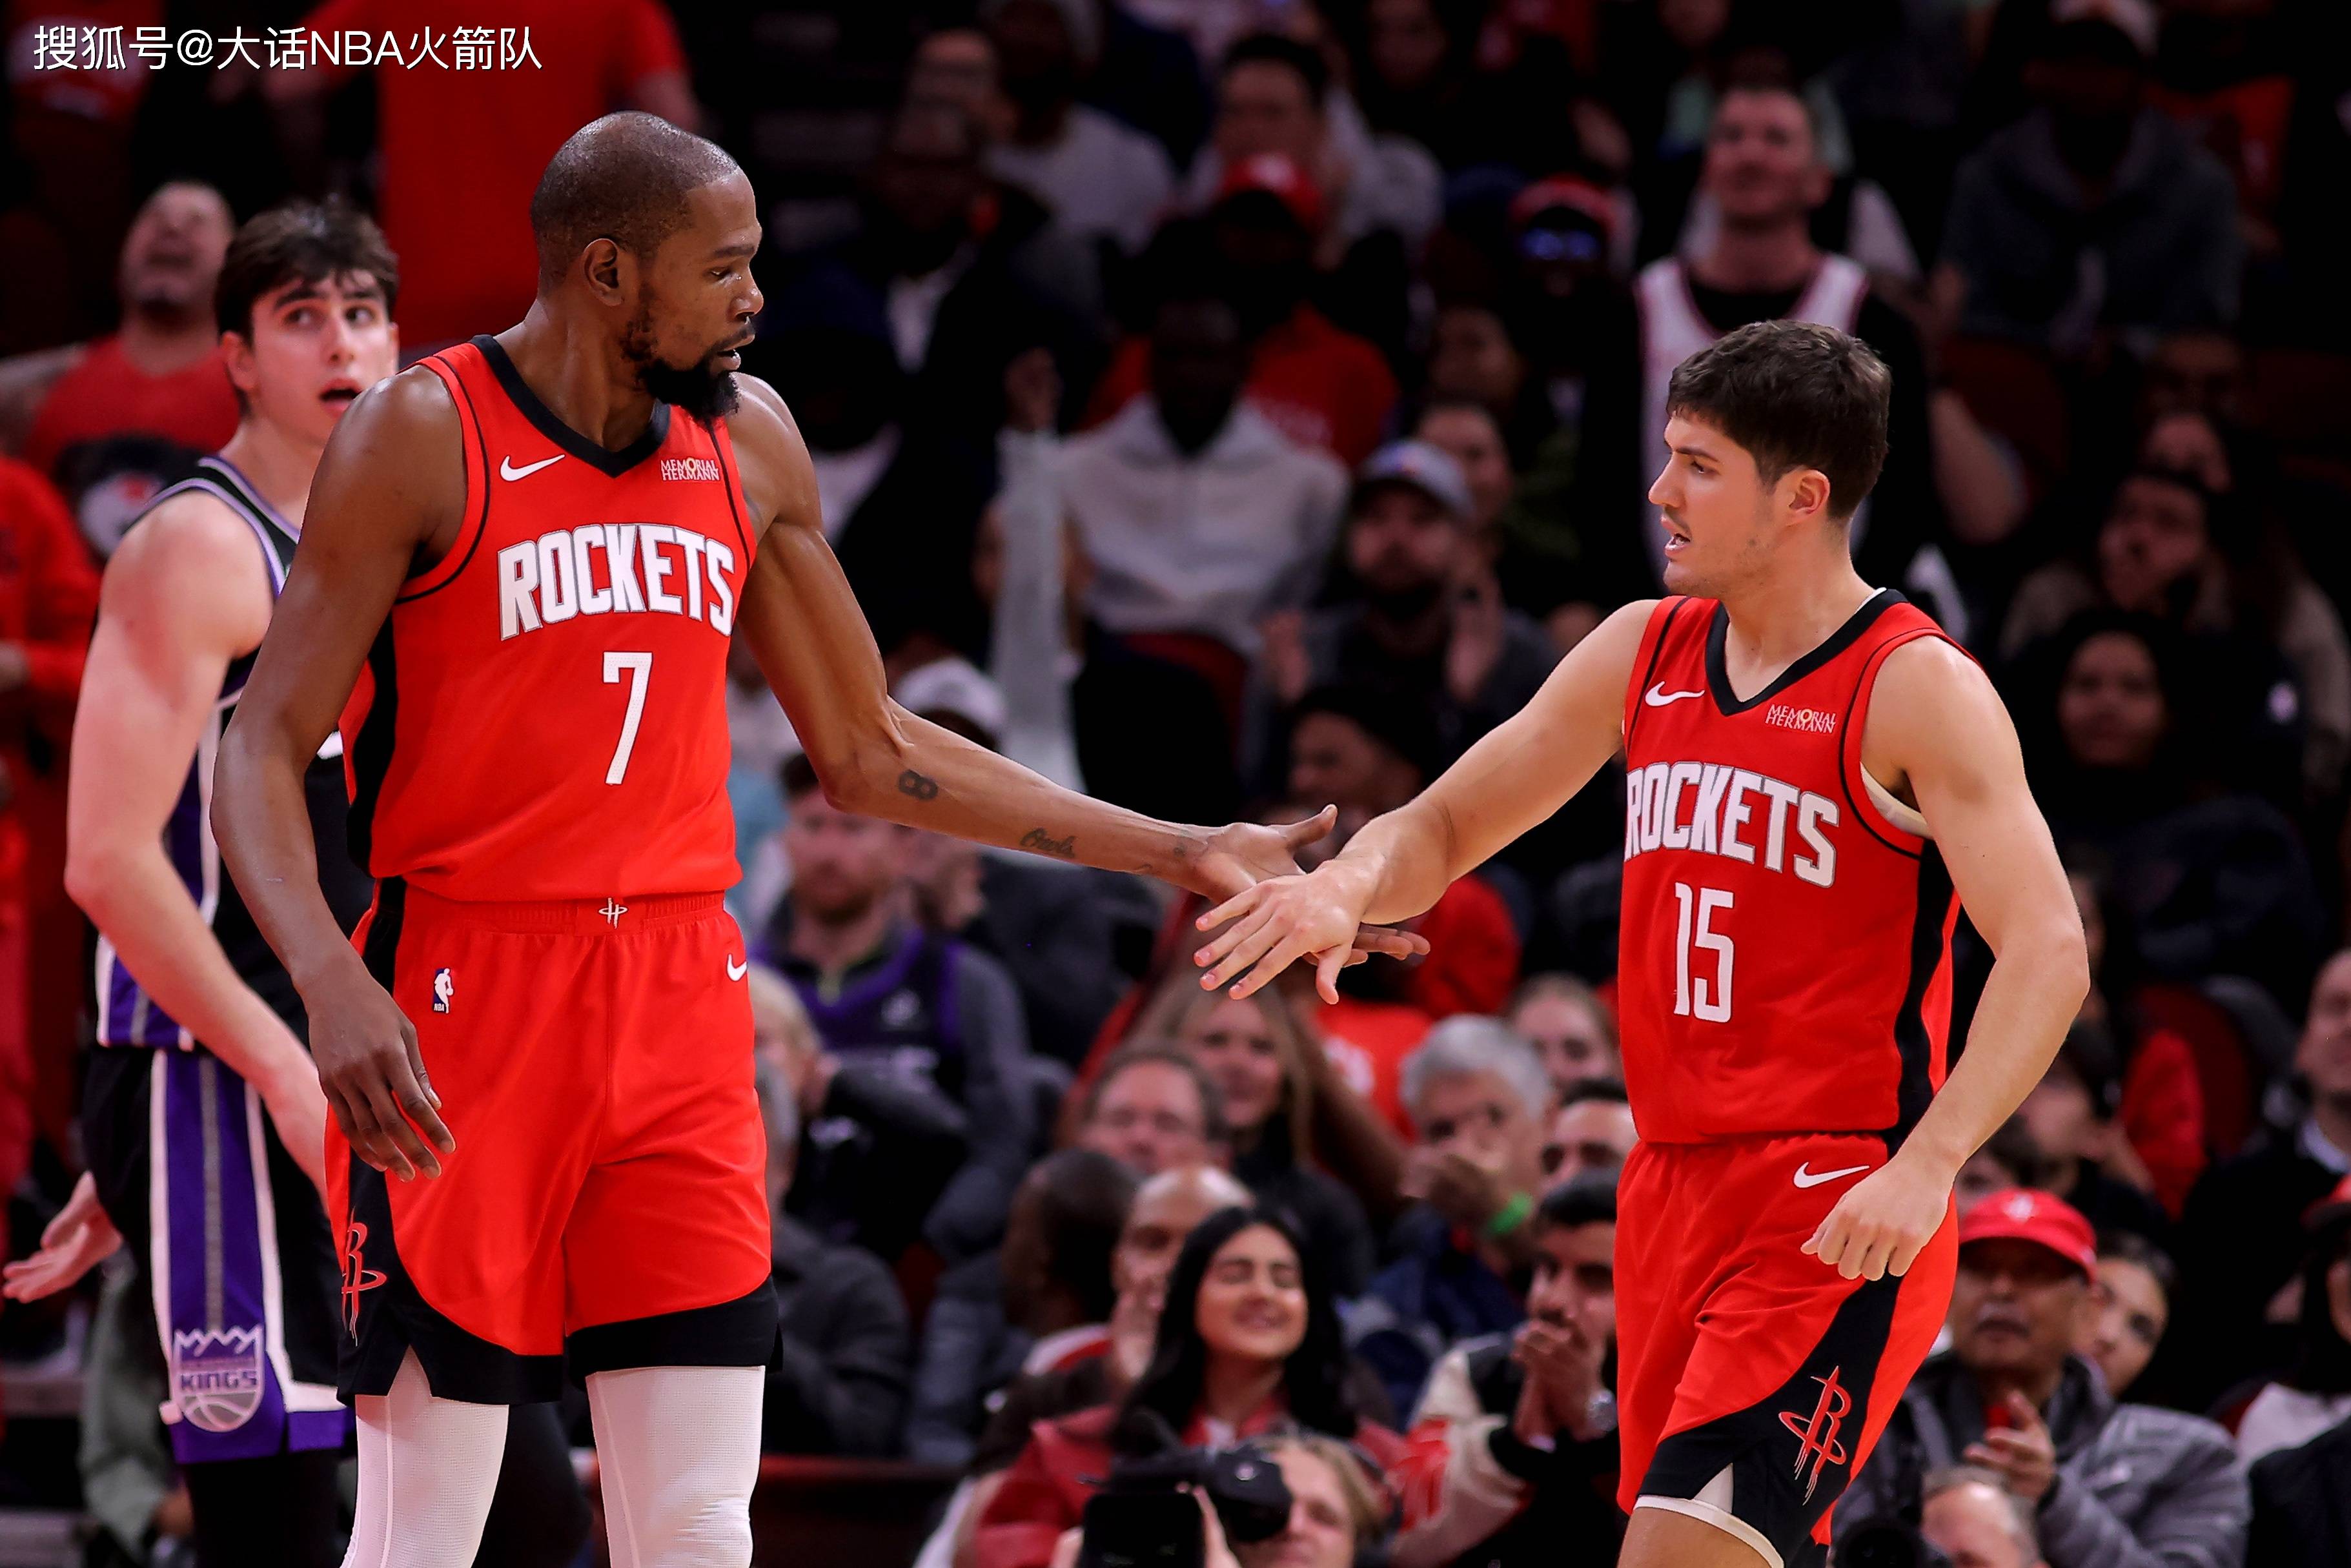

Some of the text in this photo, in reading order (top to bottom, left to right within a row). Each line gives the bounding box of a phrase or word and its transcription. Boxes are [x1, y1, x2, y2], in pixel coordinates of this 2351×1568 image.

[660, 457, 718, 471] MEMORIAL
[661, 469, 720, 481] HERMANN
[497, 522, 735, 642] ROCKETS
[602, 651, 653, 786] 7
[1765, 712, 1837, 734] HERMANN
[1768, 703, 1837, 725] MEMORIAL
[1624, 760, 1840, 889] ROCKETS
[1674, 882, 1735, 1023] 15
[181, 1370, 257, 1390] KINGS
